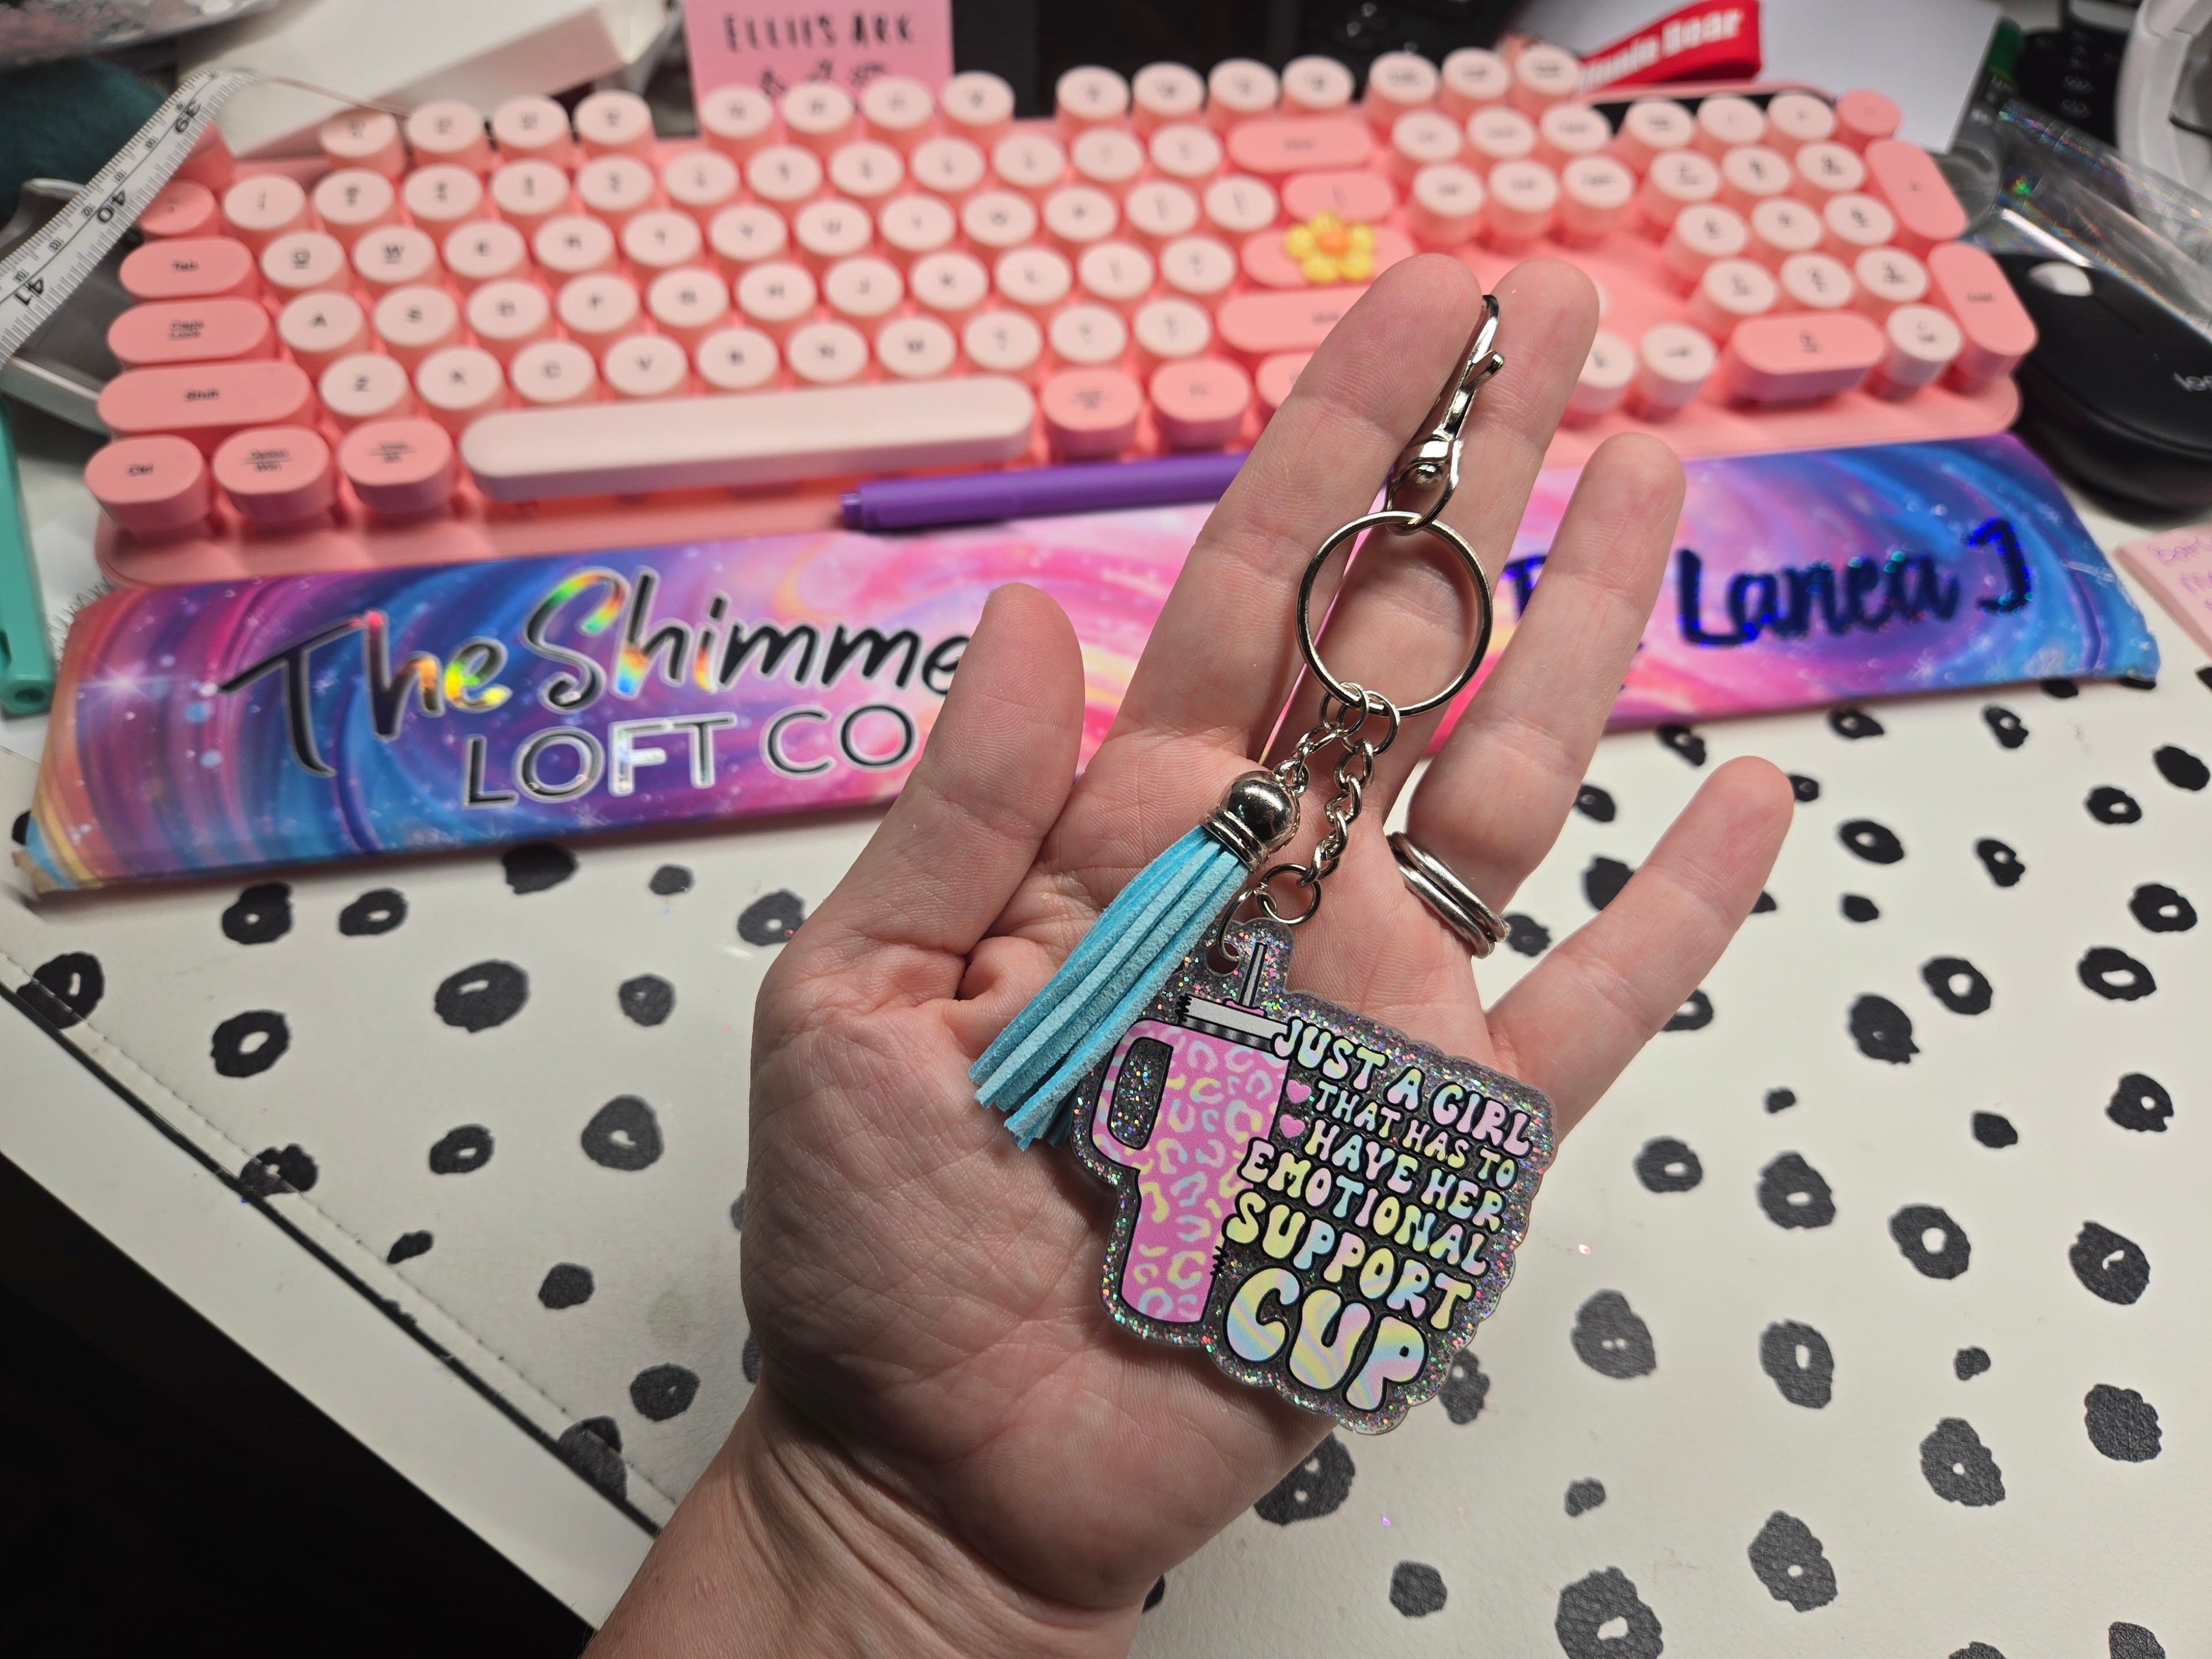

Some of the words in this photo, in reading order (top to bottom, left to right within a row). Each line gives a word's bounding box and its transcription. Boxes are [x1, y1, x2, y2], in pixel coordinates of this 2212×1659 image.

[174, 99, 202, 134] 39
[96, 190, 126, 223] 40
[14, 276, 44, 306] 41
[310, 312, 328, 328] A
[354, 375, 370, 392] Z
[127, 464, 154, 476] Ctrl
[218, 607, 513, 778] The
[464, 712, 737, 807] LOFT
[760, 702, 919, 777] CO
[1271, 1017, 1389, 1090] JUST
[1386, 1066, 1425, 1111] A
[1429, 1081, 1534, 1157] GIRL
[1314, 1080, 1402, 1139] THAT
[1401, 1119, 1471, 1171] HAS
[1478, 1148, 1520, 1190] TO
[1237, 1138, 1491, 1277] EMOTIONAL
[1303, 1118, 1421, 1194] HAVE
[1420, 1167, 1506, 1233] HER
[1221, 1190, 1476, 1330] SUPPORT
[1222, 1266, 1430, 1412] CUP
